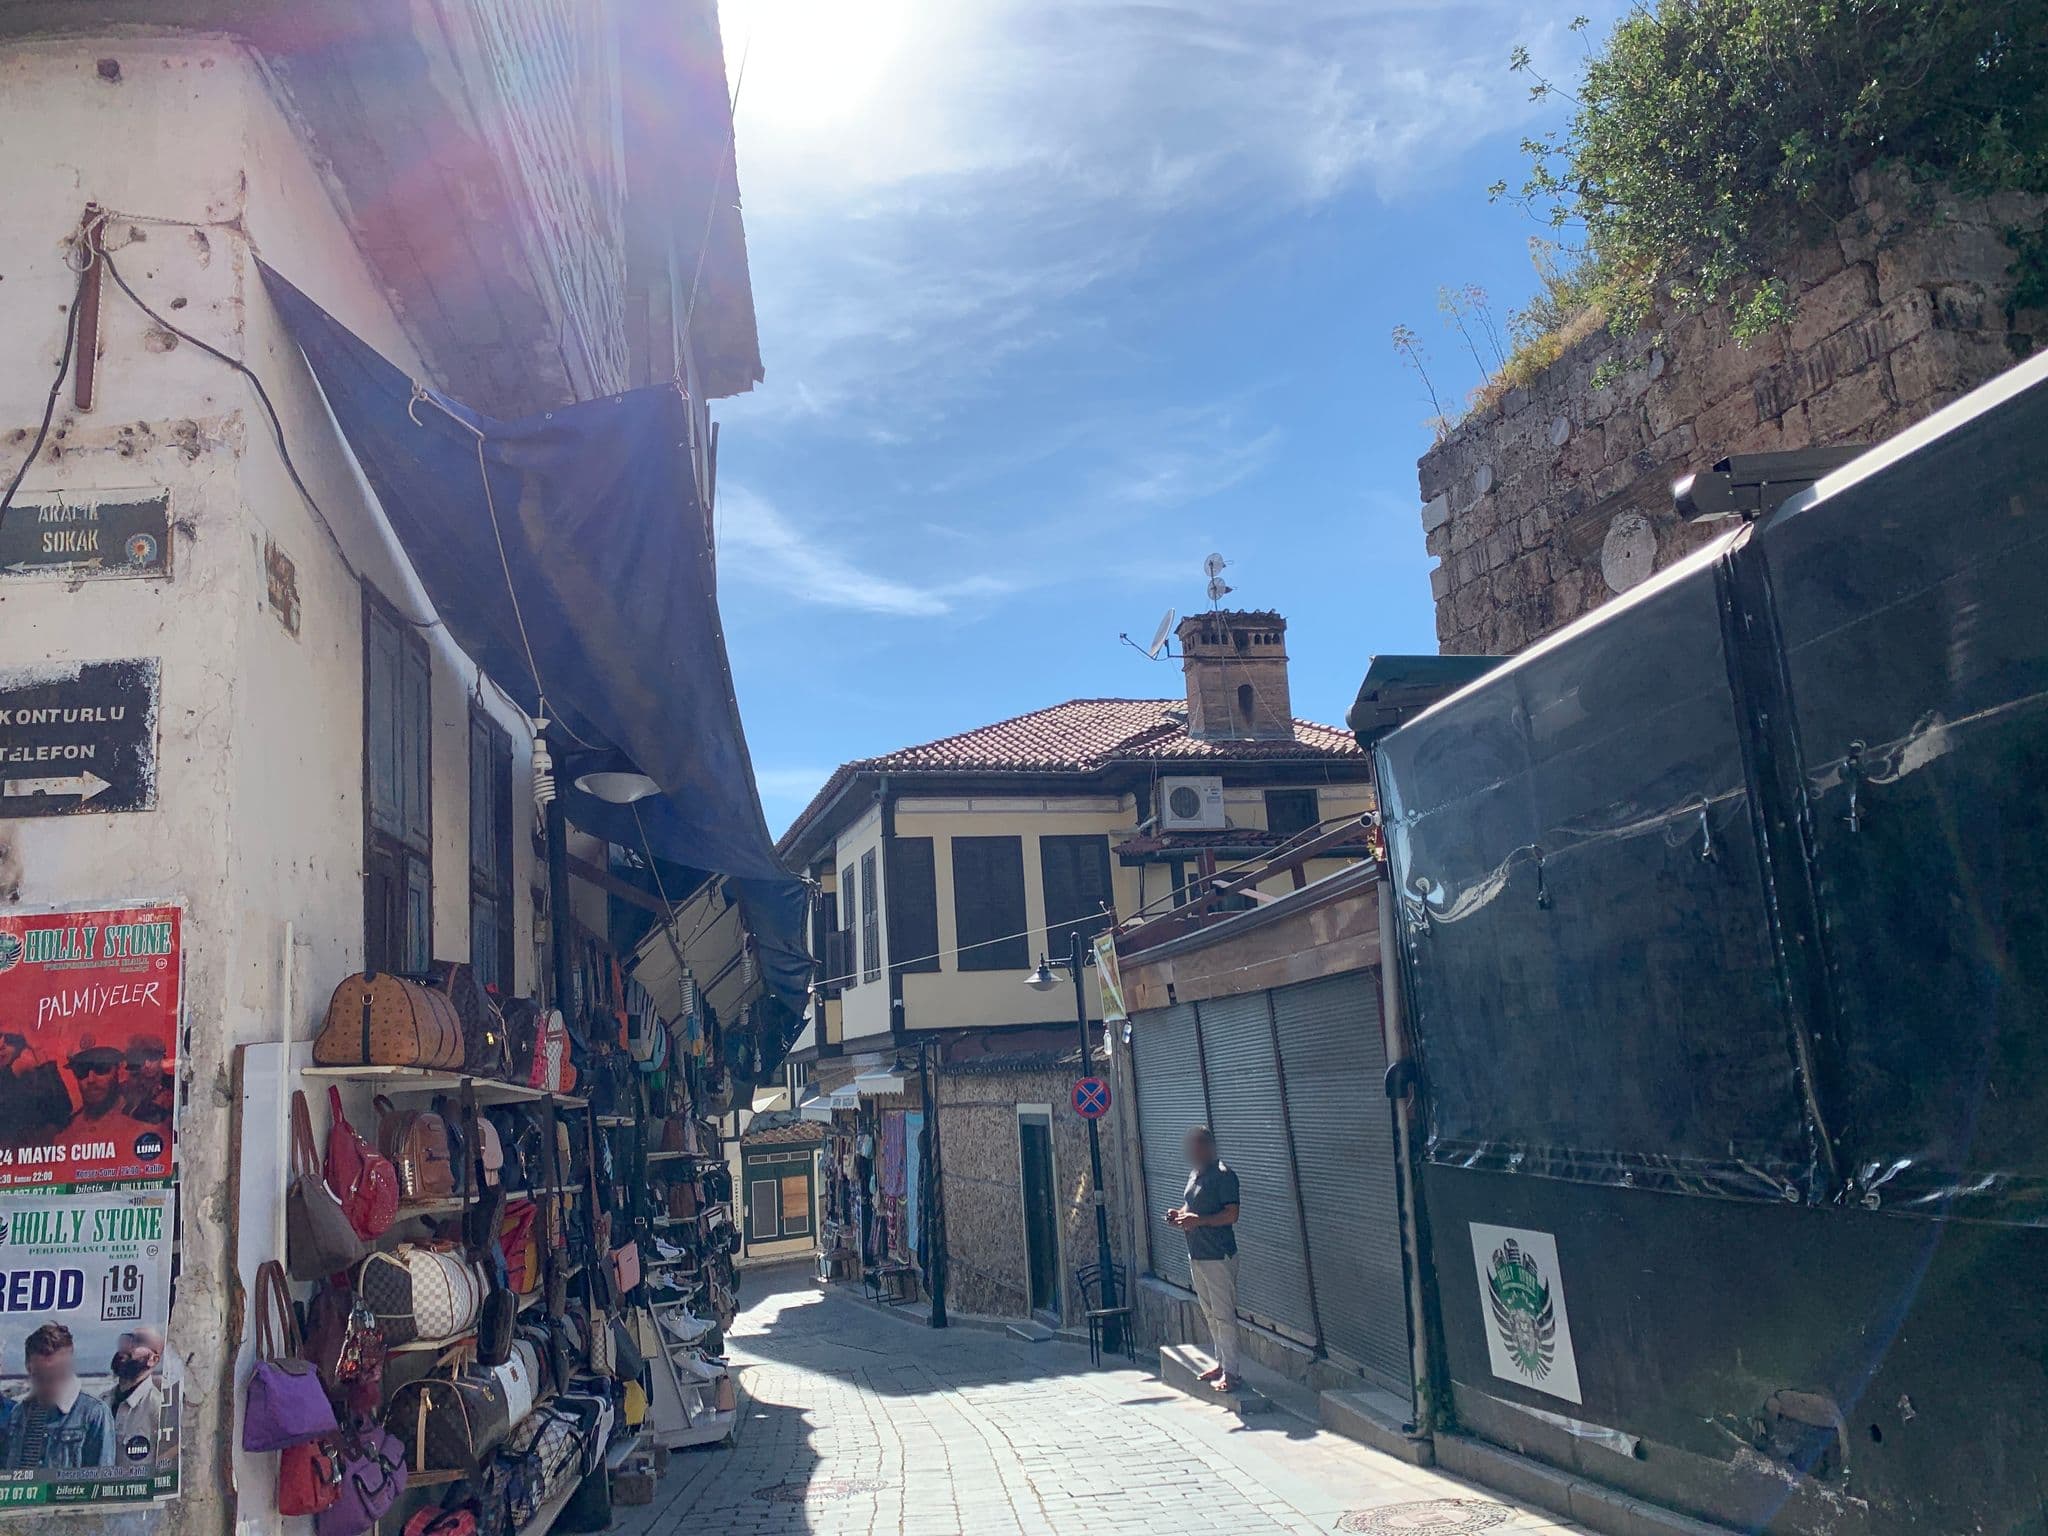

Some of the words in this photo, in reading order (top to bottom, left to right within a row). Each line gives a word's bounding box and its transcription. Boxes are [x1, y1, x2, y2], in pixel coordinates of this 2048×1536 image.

[42, 529, 98, 552] SOKAK
[0, 706, 125, 725] KONTURLU
[0, 744, 95, 761] TELEFON
[24, 928, 98, 963] HOLLY
[104, 922, 172, 958] STONE
[38, 982, 160, 1030] PALMİYELER
[18, 1145, 66, 1165] MAYIS
[71, 1142, 116, 1161] CUMA
[136, 1143, 161, 1154] LUNA
[75, 1183, 103, 1193] biletix
[10, 1210, 85, 1245] HOLLY
[93, 1207, 163, 1242] STONE
[109, 1264, 138, 1292] 18
[110, 1294, 134, 1304] MAYIS
[13, 1470, 34, 1481] 22:00
[56, 1484, 85, 1495] biletix
